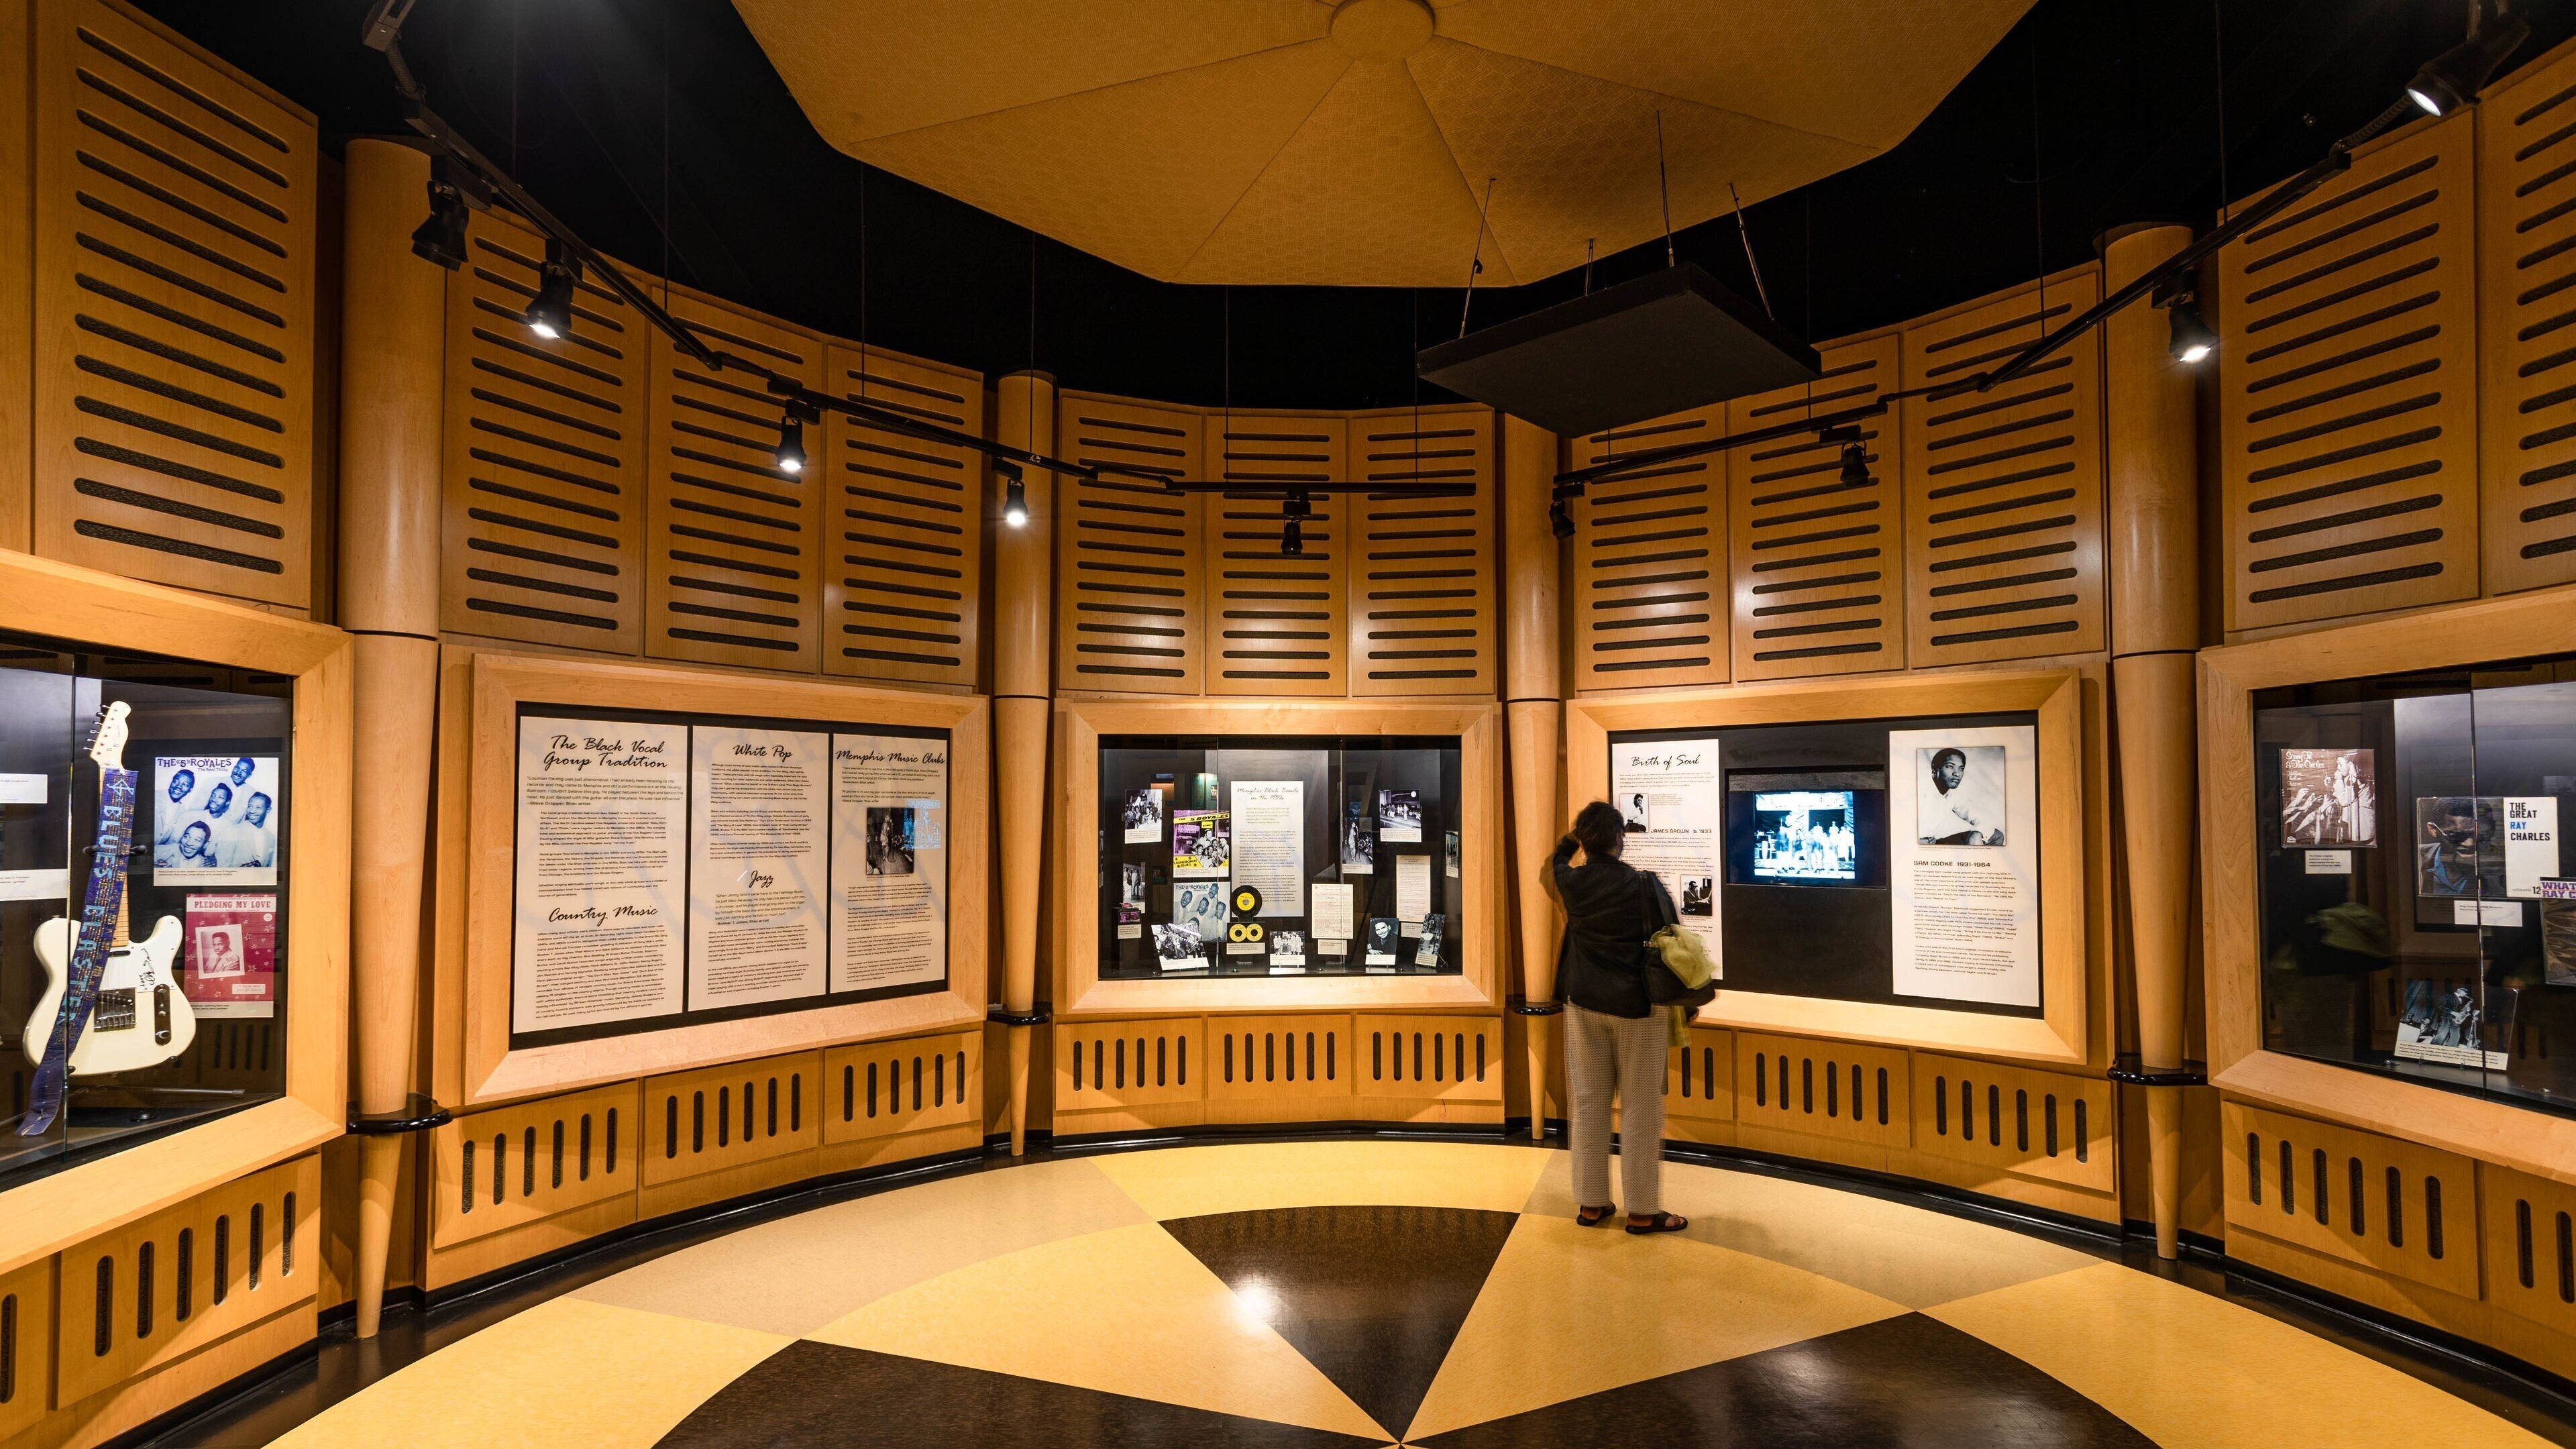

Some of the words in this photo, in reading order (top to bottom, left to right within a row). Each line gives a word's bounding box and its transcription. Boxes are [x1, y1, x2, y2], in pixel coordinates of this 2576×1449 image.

[551, 735, 578, 749] The
[584, 737, 624, 752] Black
[631, 739, 665, 753] Vocal
[733, 743, 767, 756] White
[771, 745, 793, 762] Pop
[835, 750, 885, 765] Memphis
[888, 753, 919, 763] Music
[922, 753, 945, 764] Clubs
[158, 759, 176, 767] THE
[191, 758, 231, 767] ROYALES
[543, 751, 592, 771] Group
[598, 752, 667, 768] Tradition
[1631, 756, 1660, 766] Birth
[1664, 755, 1672, 770] of
[1676, 754, 1701, 766] Soul
[2304, 759, 2325, 769] Orioles
[1237, 788, 1262, 797] Memphis
[2510, 802, 2526, 810] THE
[2510, 810, 2537, 818] GREAT
[2510, 821, 2526, 829] RAY
[93, 805, 123, 879] BLUES
[2510, 833, 2550, 841] CHARLES
[749, 870, 773, 888] Jazz
[2532, 886, 2541, 894] 12
[549, 908, 608, 926] Country
[613, 906, 658, 917] Music
